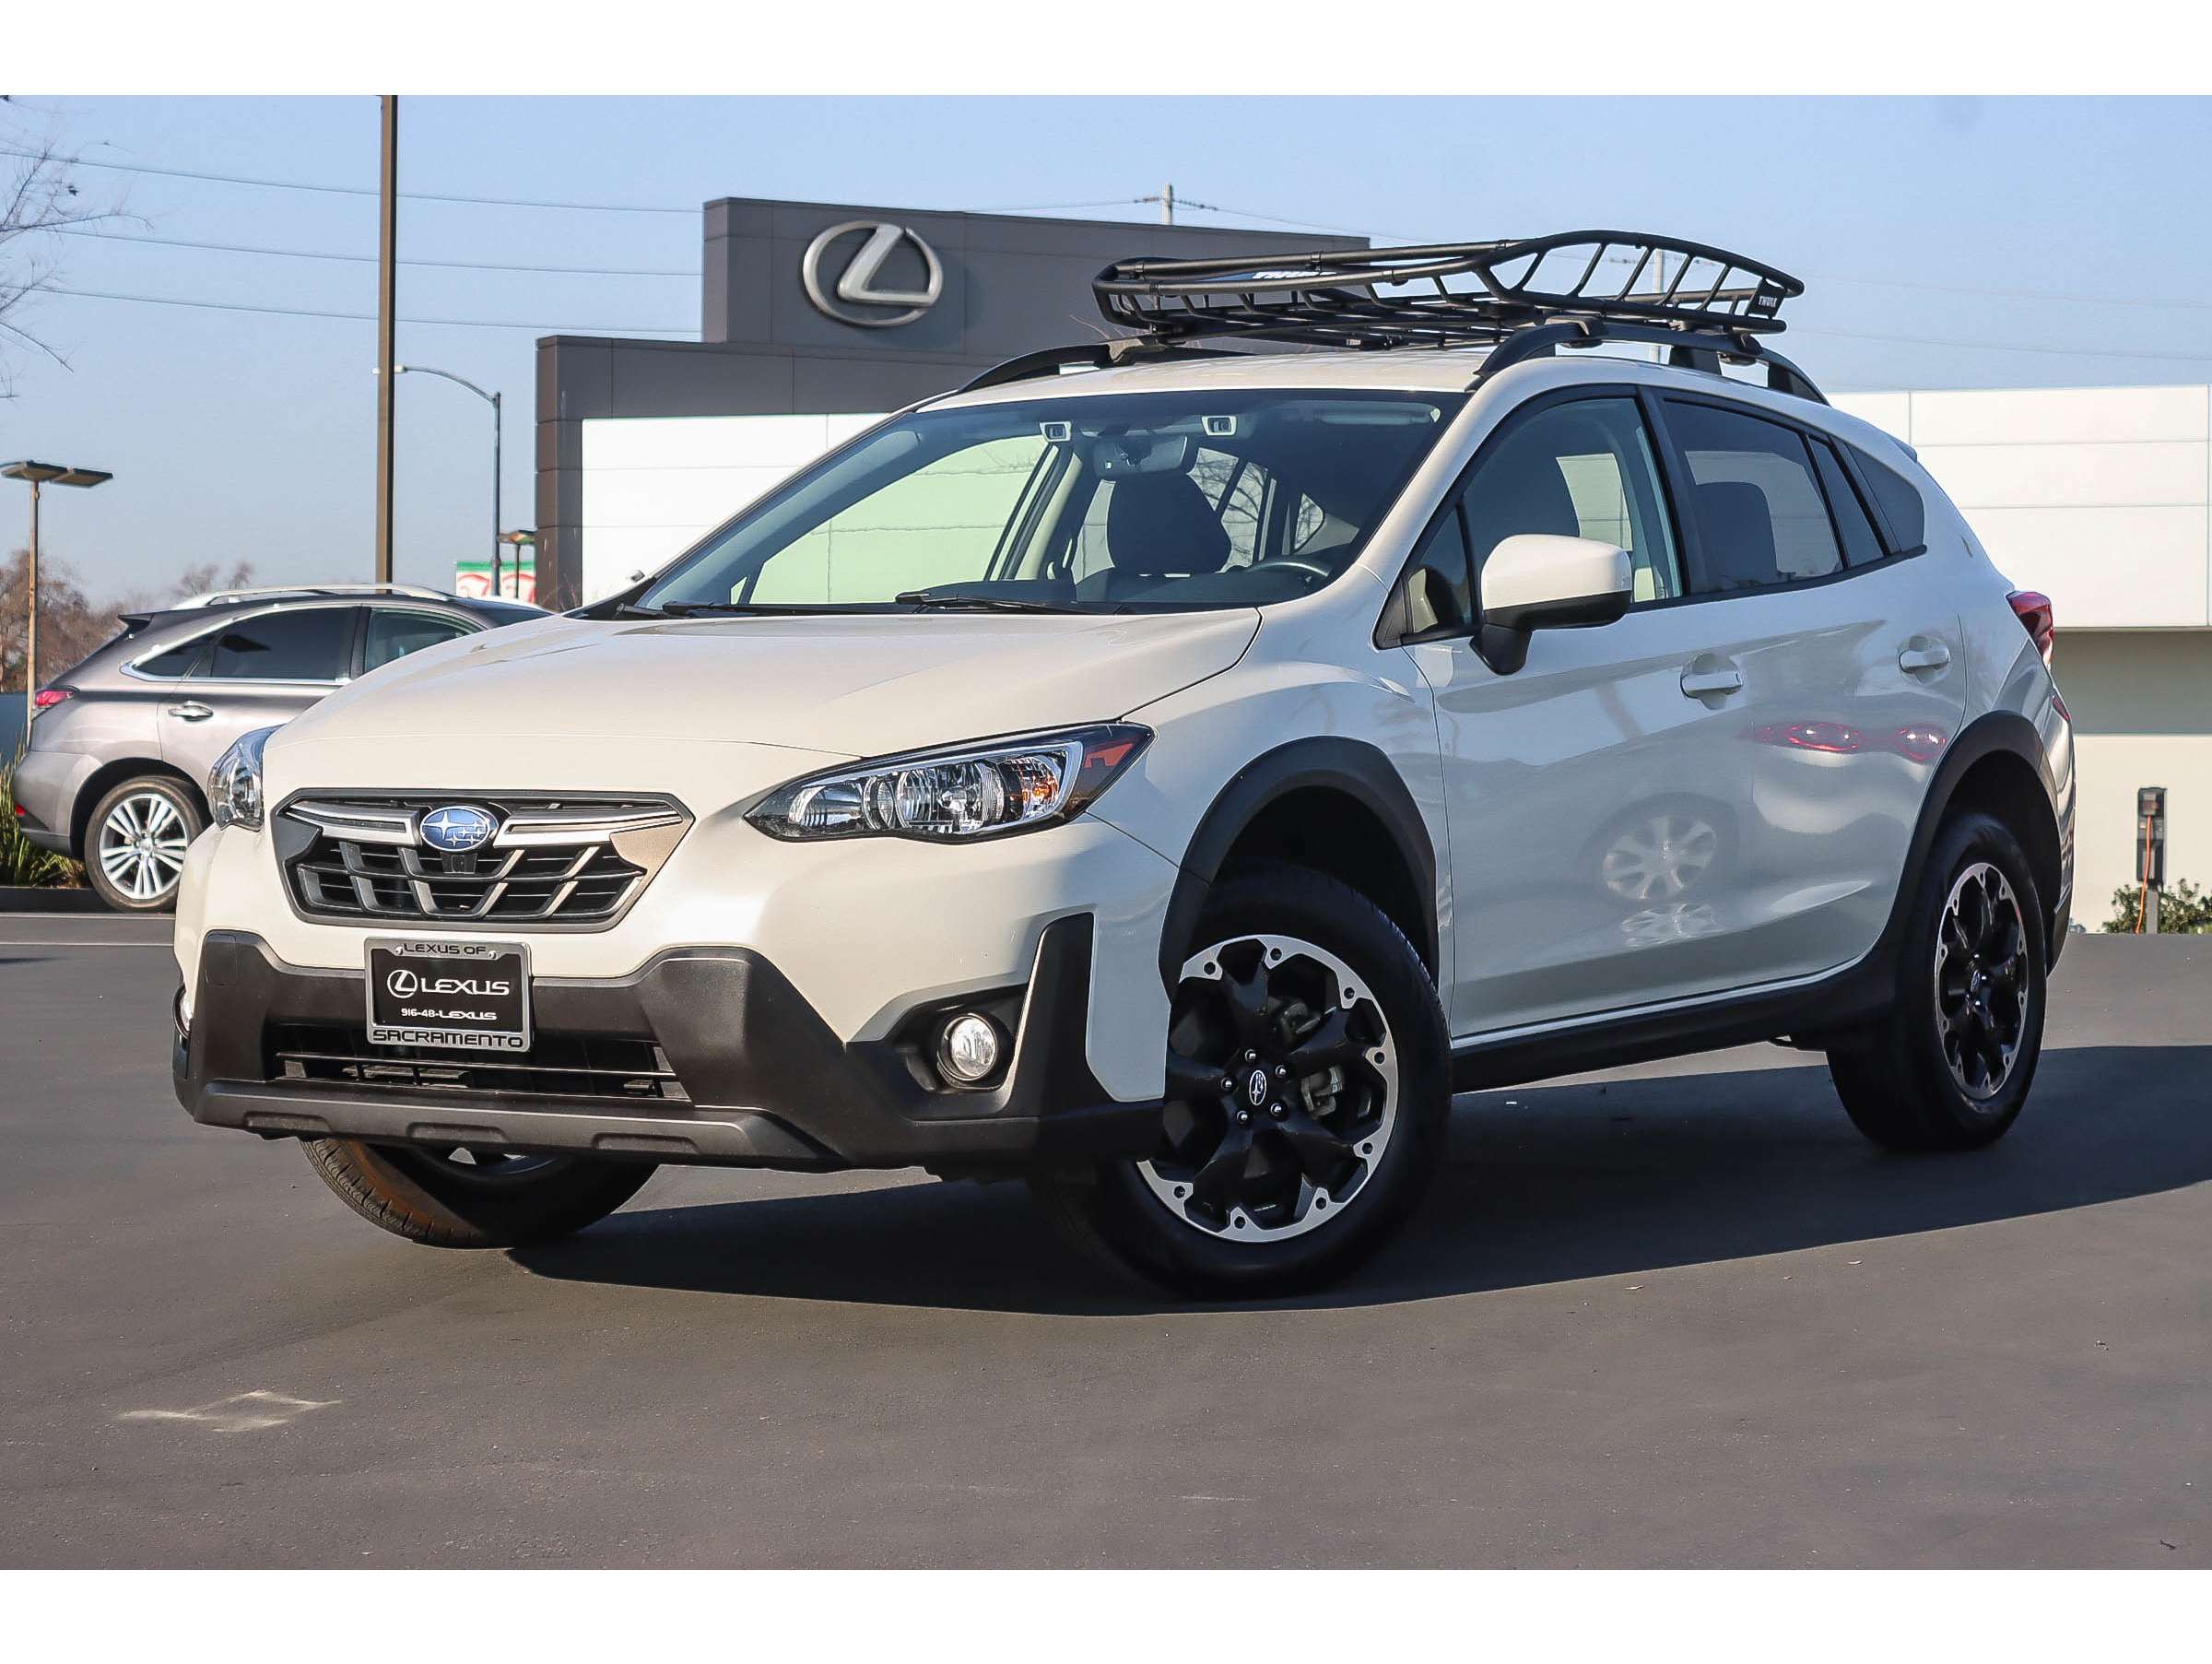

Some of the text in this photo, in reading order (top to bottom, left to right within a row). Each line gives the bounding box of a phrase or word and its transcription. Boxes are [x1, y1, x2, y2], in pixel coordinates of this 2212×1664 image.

[404, 943, 487, 955] LEXUS OF
[420, 977, 510, 996] LEXUS
[401, 1008, 498, 1021] 916-48-LEXUS
[372, 1029, 524, 1048] SACRAMENTO
